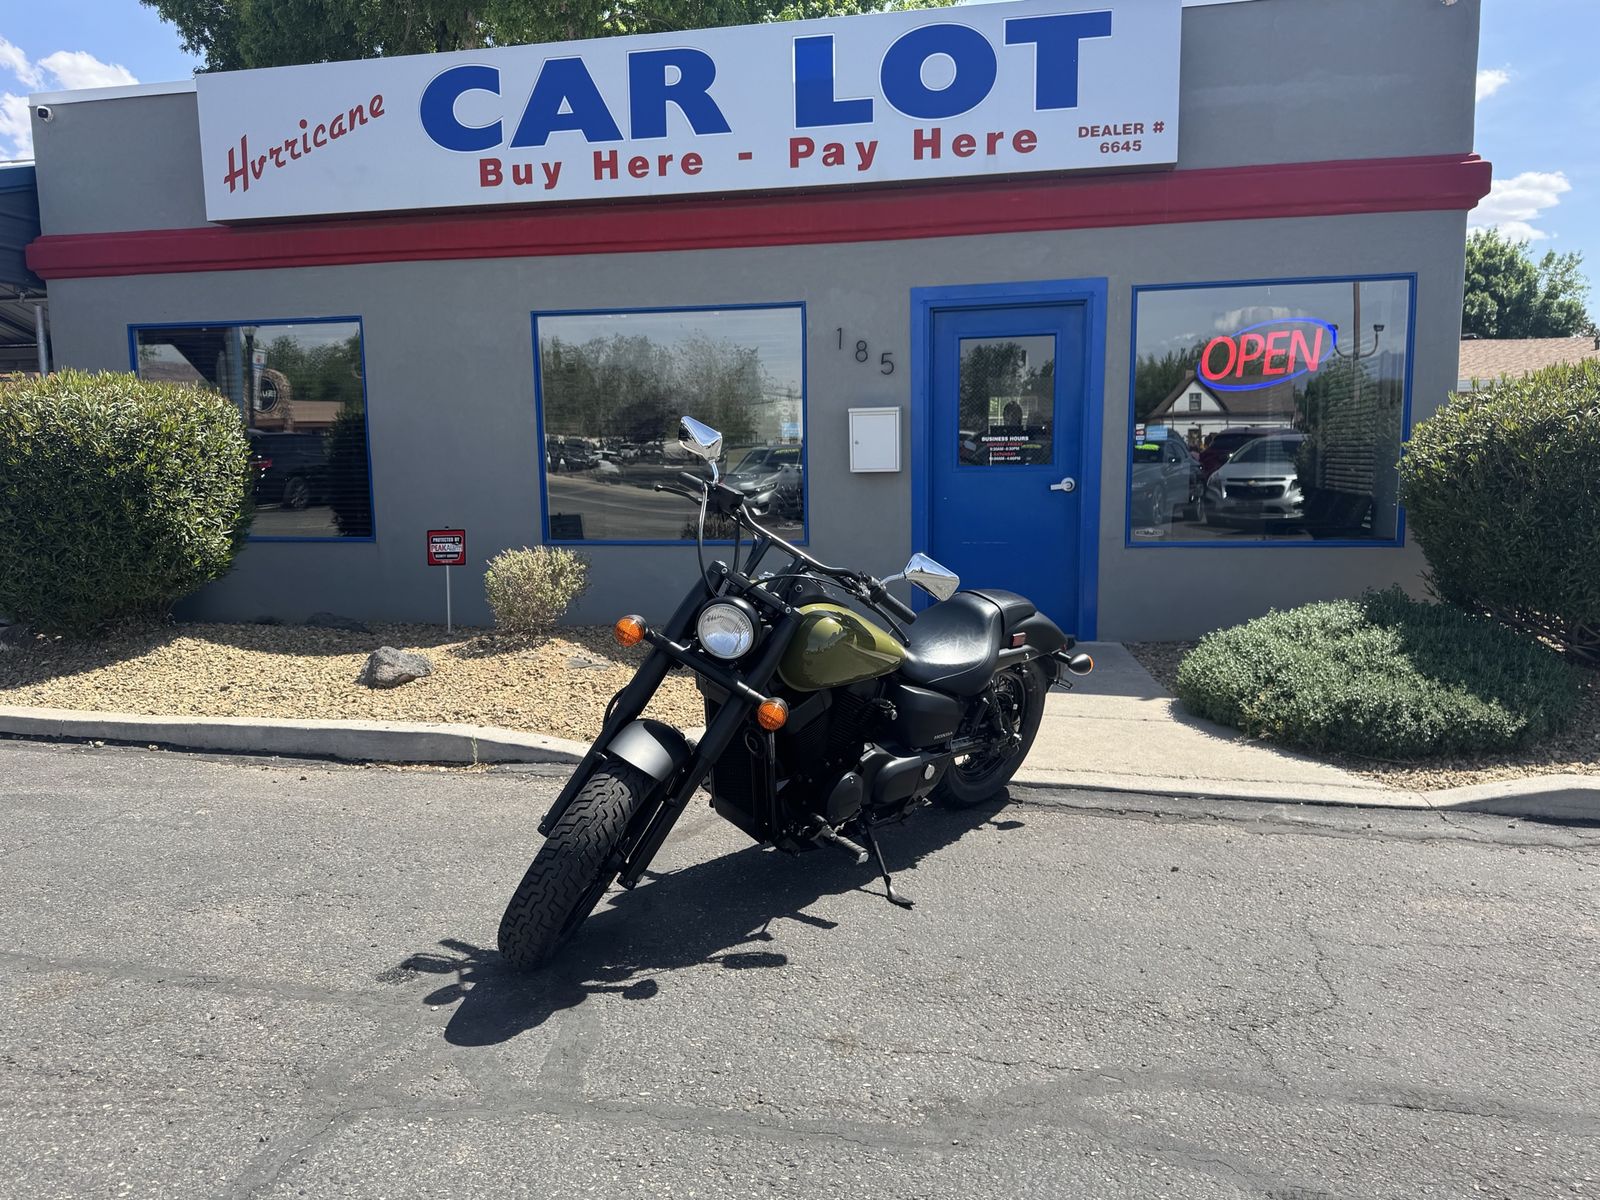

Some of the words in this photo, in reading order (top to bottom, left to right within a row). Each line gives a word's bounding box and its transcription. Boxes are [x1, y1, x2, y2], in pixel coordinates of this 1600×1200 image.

[418, 47, 733, 153] CAR
[793, 9, 1116, 129] LOT
[224, 94, 385, 193] Hurricane
[1078, 123, 1145, 139] DEALER
[1152, 121, 1165, 134] #
[1099, 140, 1143, 154] 6645
[479, 157, 562, 190] Buy
[592, 150, 704, 181] Here
[789, 136, 878, 172] Pay
[913, 127, 1038, 161] Here
[836, 327, 895, 376] 185
[1200, 327, 1323, 381] OPEN
[934, 731, 953, 740] HONDA
